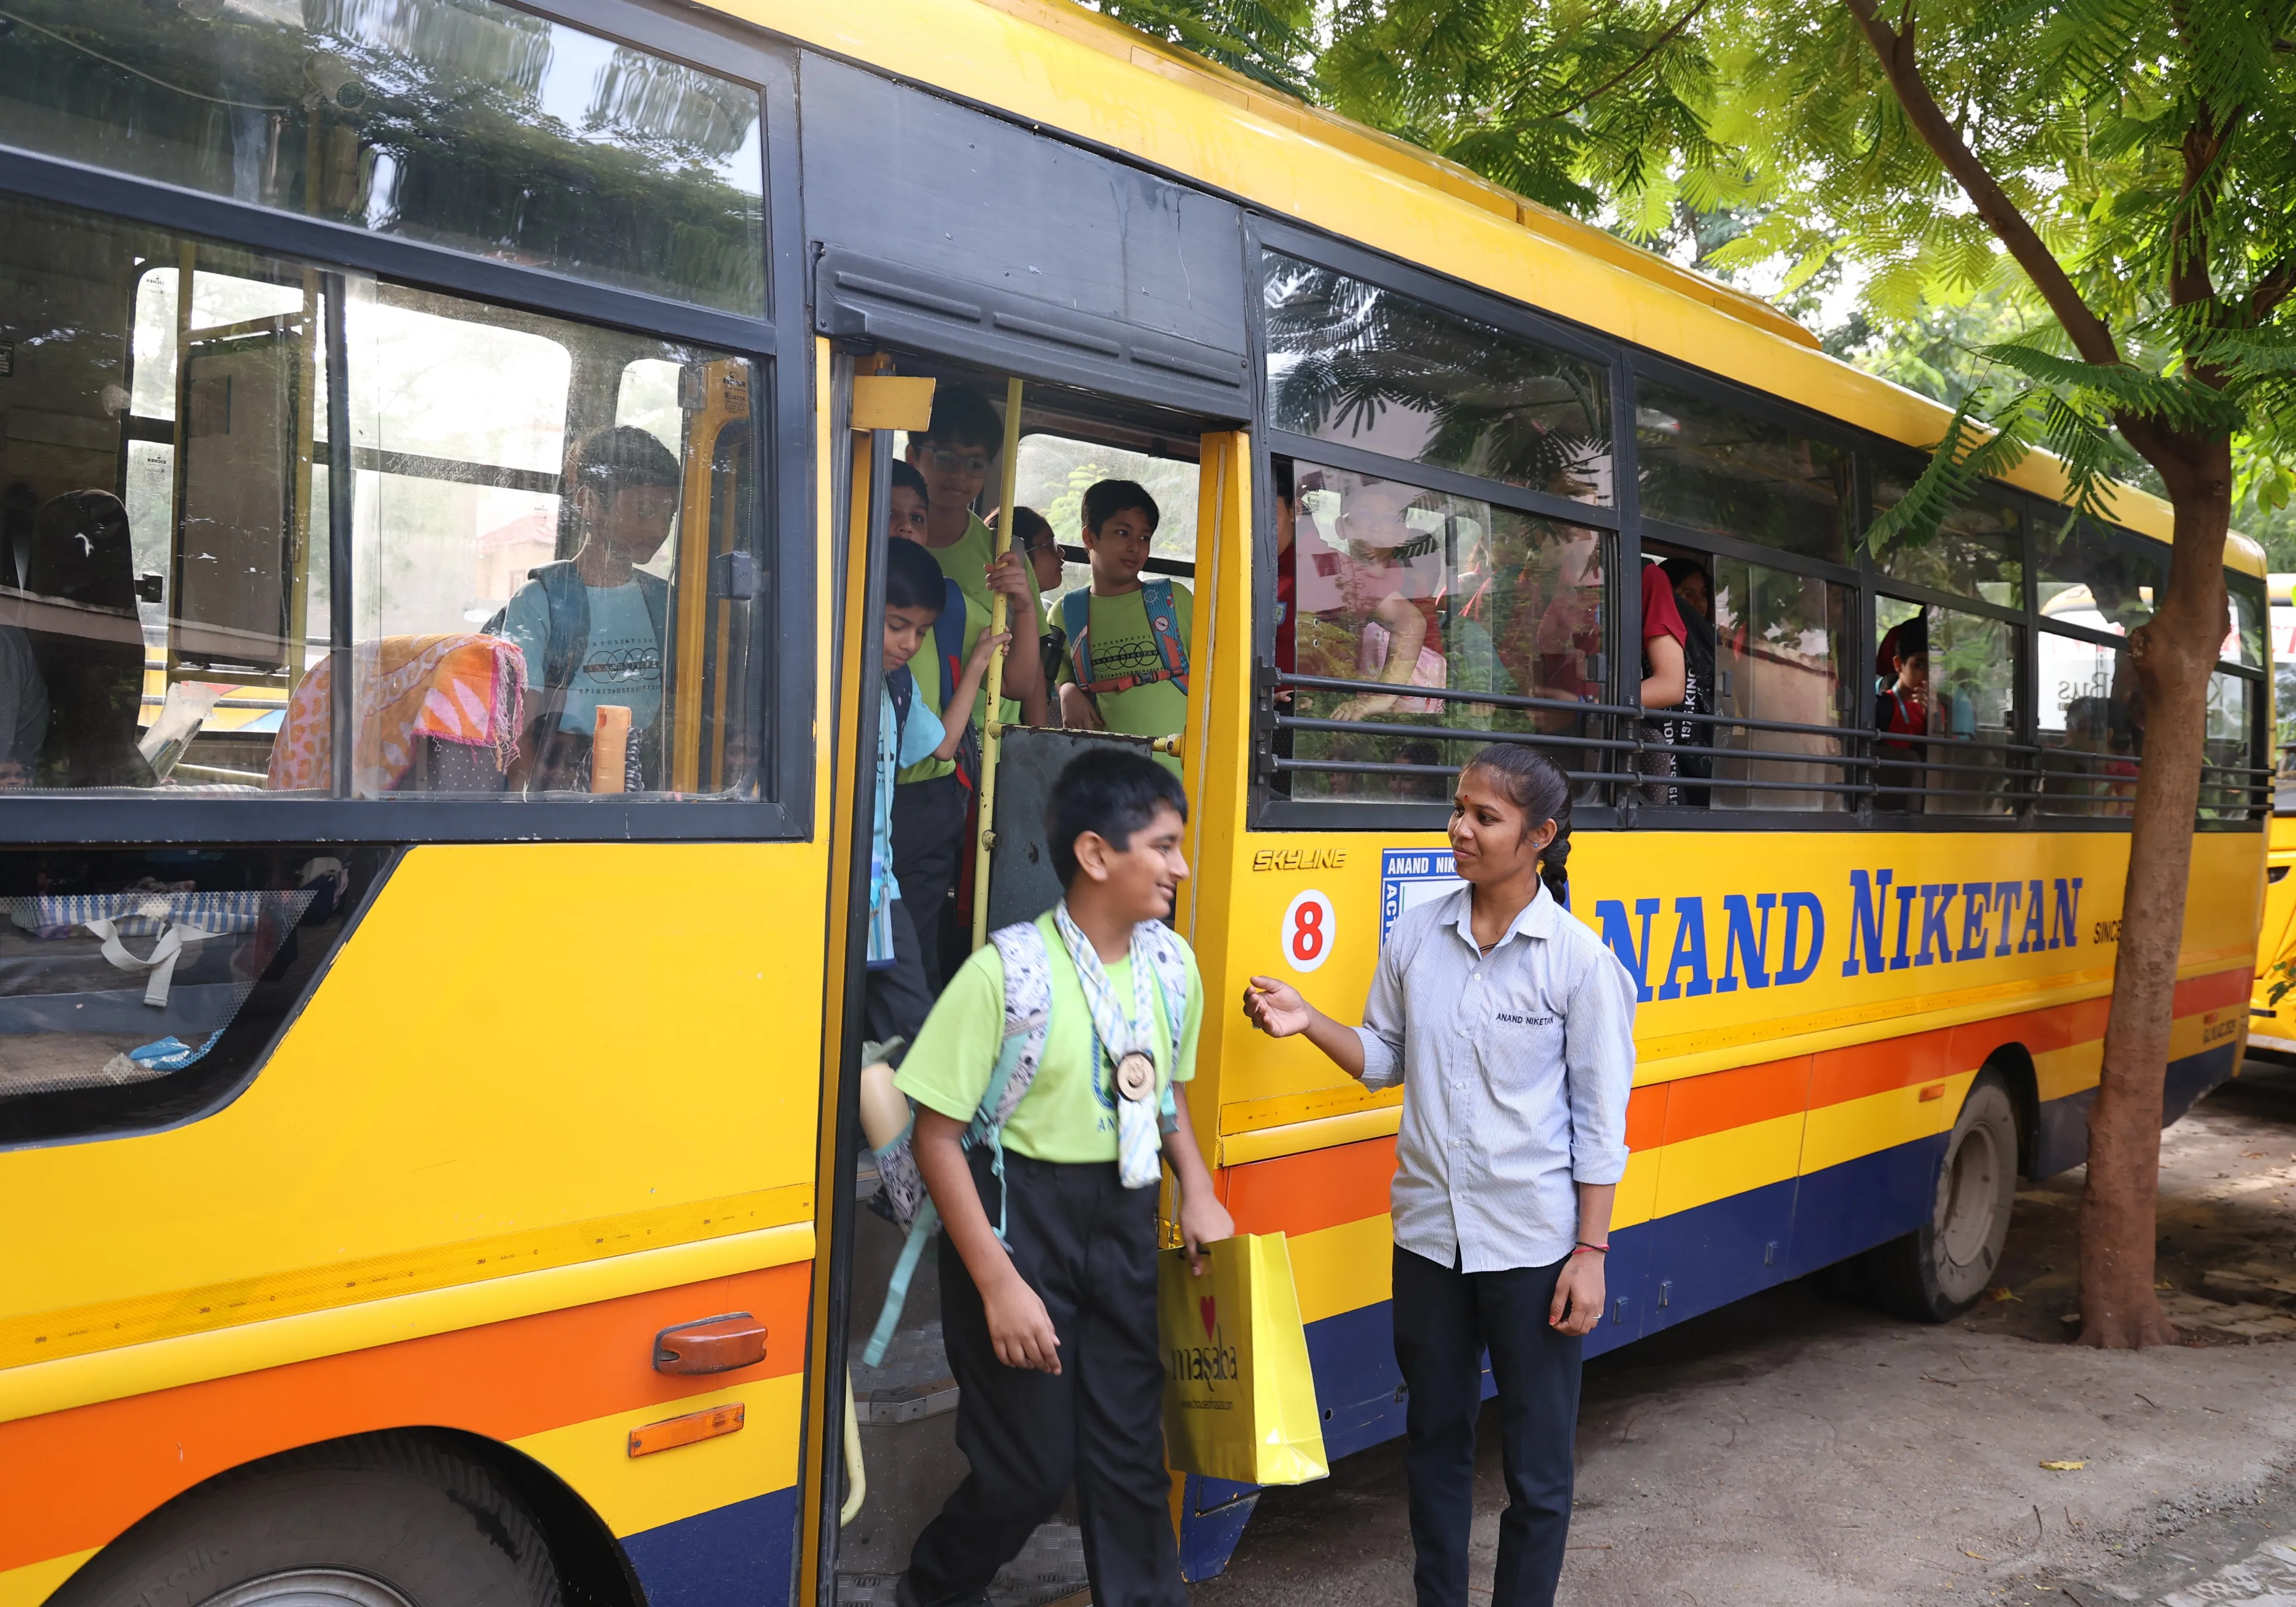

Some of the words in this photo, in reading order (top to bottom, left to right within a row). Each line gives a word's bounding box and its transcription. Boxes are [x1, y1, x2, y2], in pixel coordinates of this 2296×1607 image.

[1093, 638, 1119, 647] RPOSE
[1092, 656, 1118, 665] ANAND
[1121, 650, 1158, 660] NIKETAN
[1253, 848, 1346, 872] SKYLINE
[1387, 857, 1429, 874] ANAND
[1436, 856, 1457, 873] NIK
[1292, 901, 1323, 961] 8
[1562, 879, 1825, 1003] NAND
[1842, 868, 2083, 978] NIKETAN
[1496, 1013, 1523, 1024] ANAND
[1526, 1015, 1554, 1026] NIKETAN
[1171, 1322, 1238, 1392] masaba
